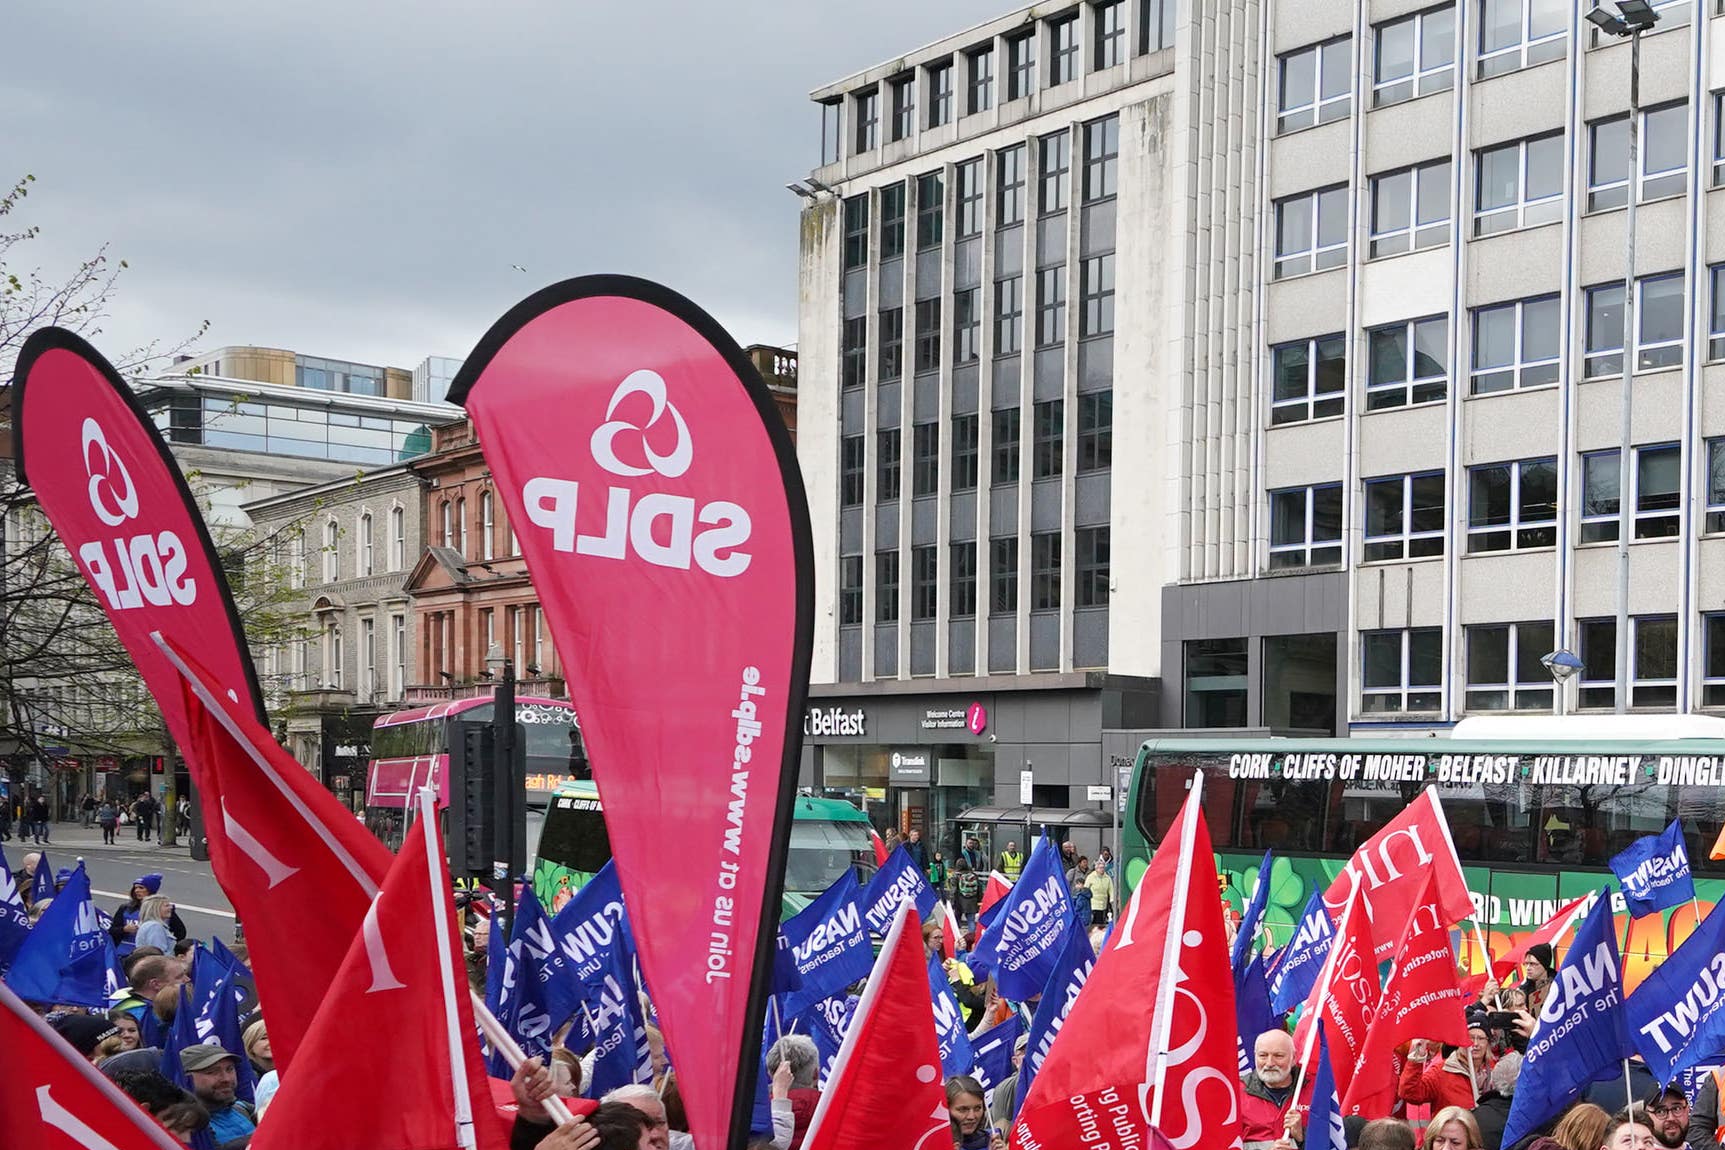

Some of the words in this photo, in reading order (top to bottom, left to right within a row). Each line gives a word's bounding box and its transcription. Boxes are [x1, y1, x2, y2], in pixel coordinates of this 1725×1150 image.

[812, 708, 865, 737] Belfast
[1229, 754, 1271, 780] CORK
[1283, 755, 1338, 780] CLIFFS
[1339, 755, 1362, 781] OF
[1363, 755, 1426, 782] MOHER
[1437, 755, 1518, 784] BELFAST
[1531, 757, 1643, 786] KILLARNEY
[1108, 1103, 1142, 1150] Public
